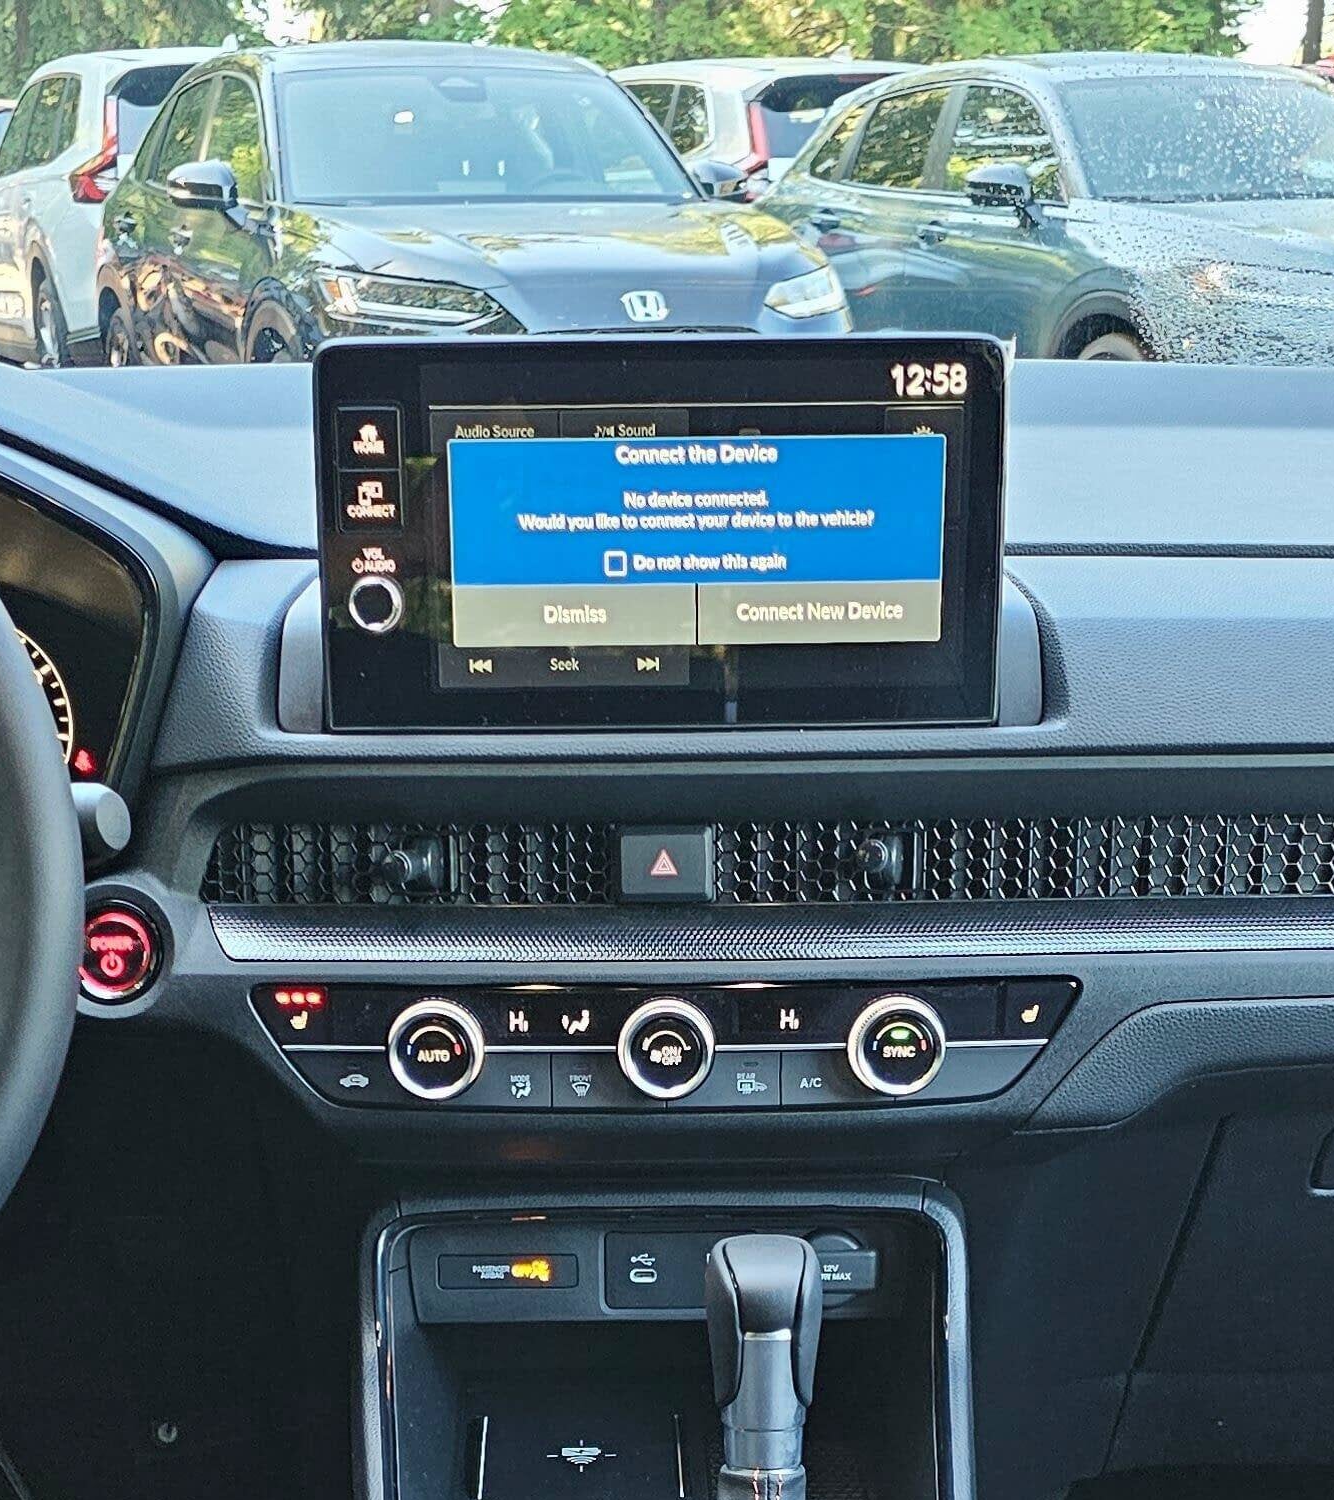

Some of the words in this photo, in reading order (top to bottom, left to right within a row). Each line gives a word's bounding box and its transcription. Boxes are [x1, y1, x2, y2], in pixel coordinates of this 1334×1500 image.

[891, 362, 967, 397] 12:58
[455, 424, 490, 438] Audio
[492, 424, 535, 438] Source
[618, 424, 656, 437] Sound
[615, 445, 686, 465] Connect
[688, 444, 717, 465] the
[720, 443, 778, 465] Device
[624, 492, 646, 509] No
[648, 491, 692, 509] device
[694, 490, 770, 508] connected.
[347, 504, 396, 519] CONNECT
[517, 513, 566, 530] Would
[567, 516, 594, 533] you
[596, 513, 620, 530] like
[622, 514, 638, 530] to
[640, 513, 697, 530] connect
[698, 514, 729, 531] your
[731, 511, 775, 529] device
[777, 512, 793, 528] to
[795, 511, 819, 528] the
[820, 510, 875, 528] vehicle?
[364, 559, 397, 573] AUDIO
[633, 554, 655, 570] Do
[657, 555, 681, 571] not
[683, 553, 720, 570] show
[722, 553, 748, 570] this
[750, 553, 787, 572] again
[544, 604, 607, 624] Dismiss
[736, 602, 803, 622] Connect
[808, 602, 844, 621] New
[848, 600, 903, 621] Device
[550, 656, 579, 672] Seek
[417, 1050, 451, 1063] AUTO
[883, 1046, 916, 1058] SYNC
[736, 1072, 756, 1080] REAR
[799, 1076, 822, 1088] A/C
[823, 1264, 839, 1273] 12V
[832, 1272, 852, 1281] MAX
